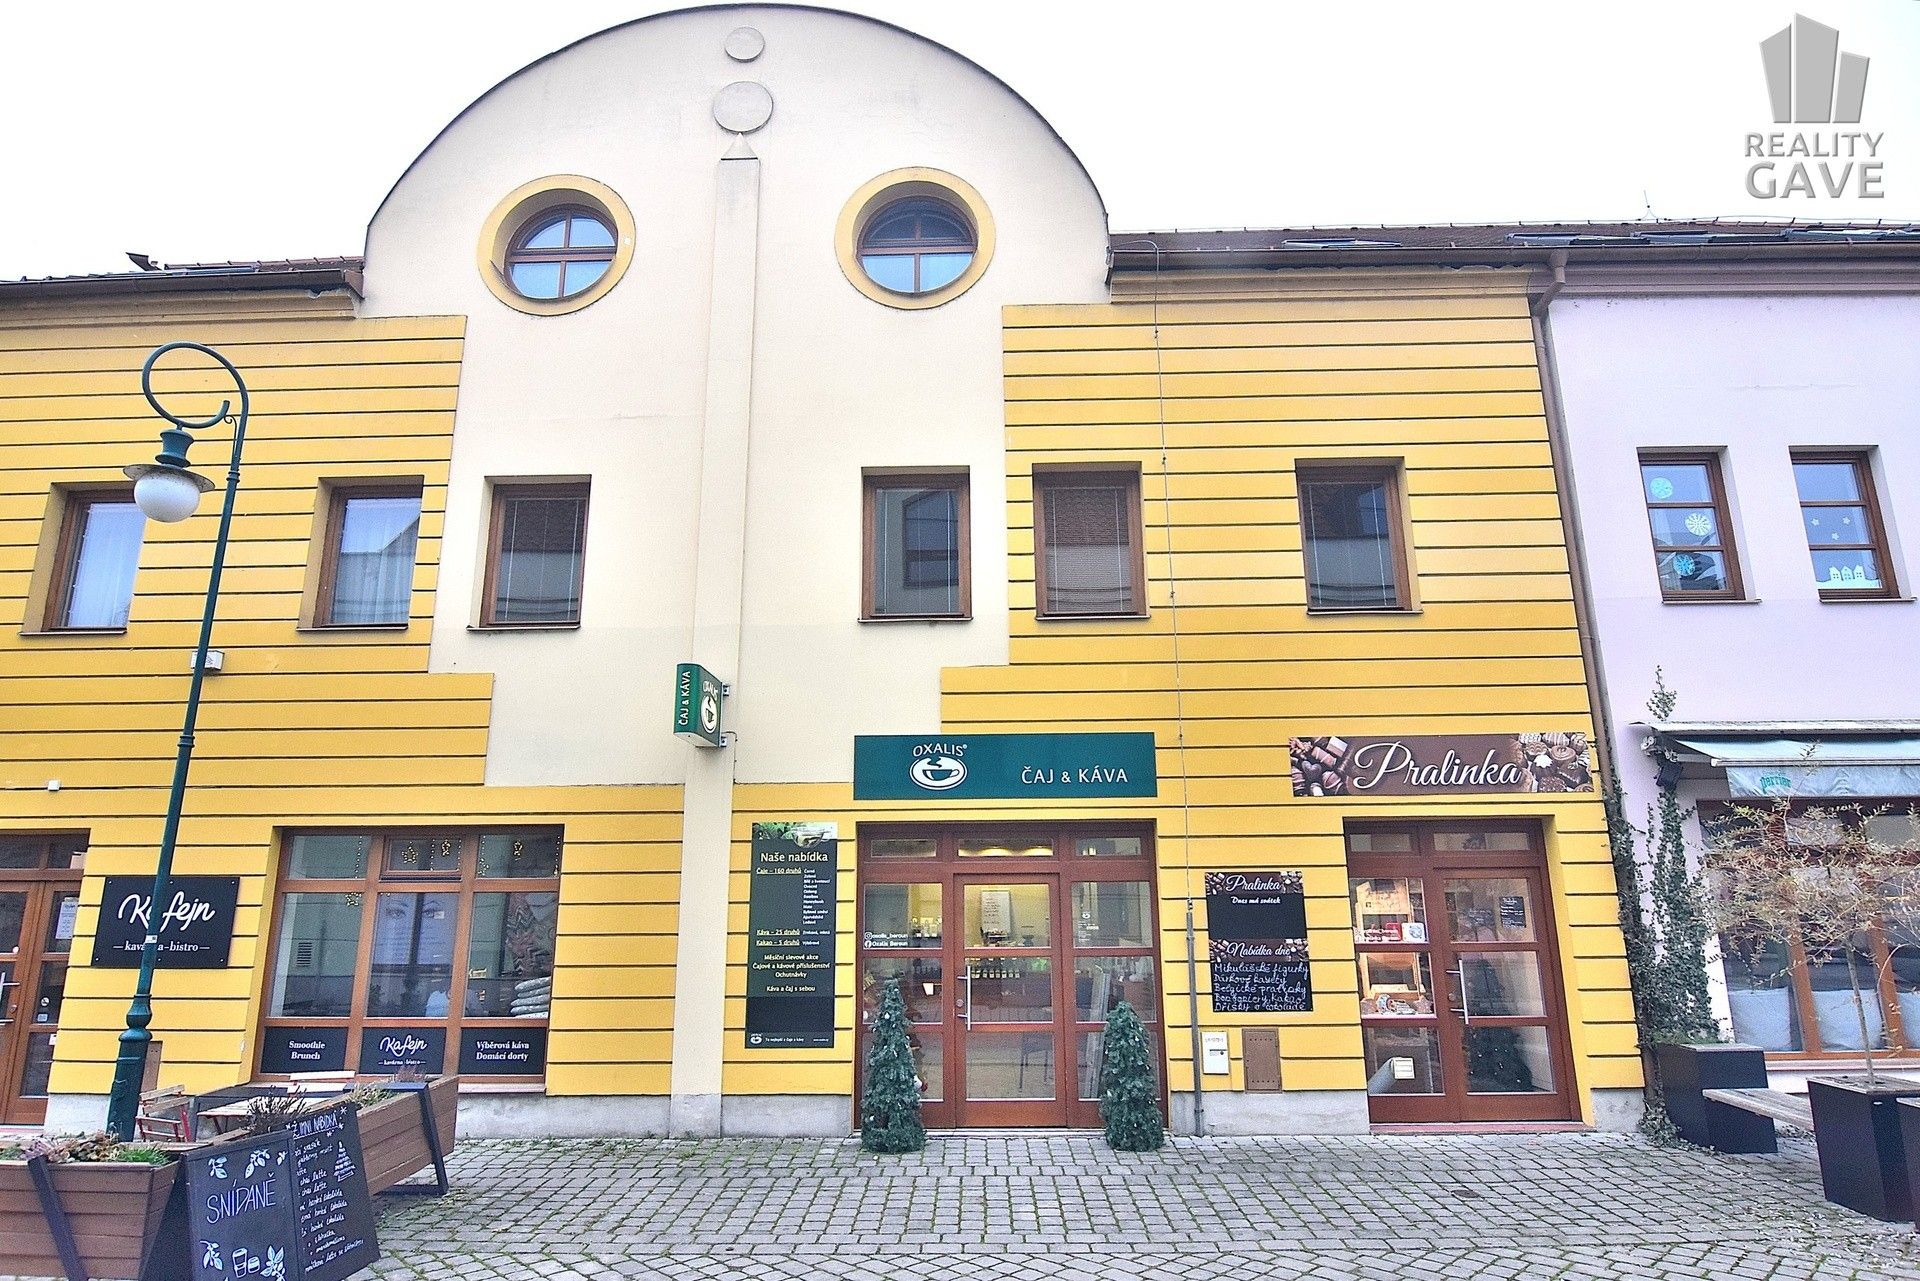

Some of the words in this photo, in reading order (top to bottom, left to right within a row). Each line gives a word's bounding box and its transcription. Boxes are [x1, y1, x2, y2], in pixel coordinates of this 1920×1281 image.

[680, 671, 691, 697] KÁVA
[678, 709, 689, 726] ČAJ
[1352, 741, 1523, 790] Pralinka
[1021, 766, 1055, 784] ČAJ
[1061, 771, 1072, 784] &
[1078, 765, 1129, 784] KÁVA
[760, 852, 785, 862] Naše
[788, 851, 828, 862] nabídka
[785, 867, 801, 875] druhů
[1226, 874, 1281, 892] Pralinka
[1230, 896, 1248, 904] Dnes
[1260, 896, 1281, 904] svátek
[1227, 942, 1272, 958] Nabídka
[1274, 944, 1291, 956] dne
[752, 962, 770, 970] Čajové
[796, 962, 831, 970] příslušenství
[785, 985, 794, 993] čaj
[289, 1041, 325, 1049] Smoothie
[380, 1034, 428, 1057] Kafejn
[476, 1041, 510, 1051] Výběrová
[512, 1041, 529, 1049] káva
[291, 1051, 320, 1060] Brunch
[476, 1052, 507, 1060] Domácí
[507, 1052, 529, 1062] dorty
[206, 1172, 276, 1224] SNÍDANĚ
